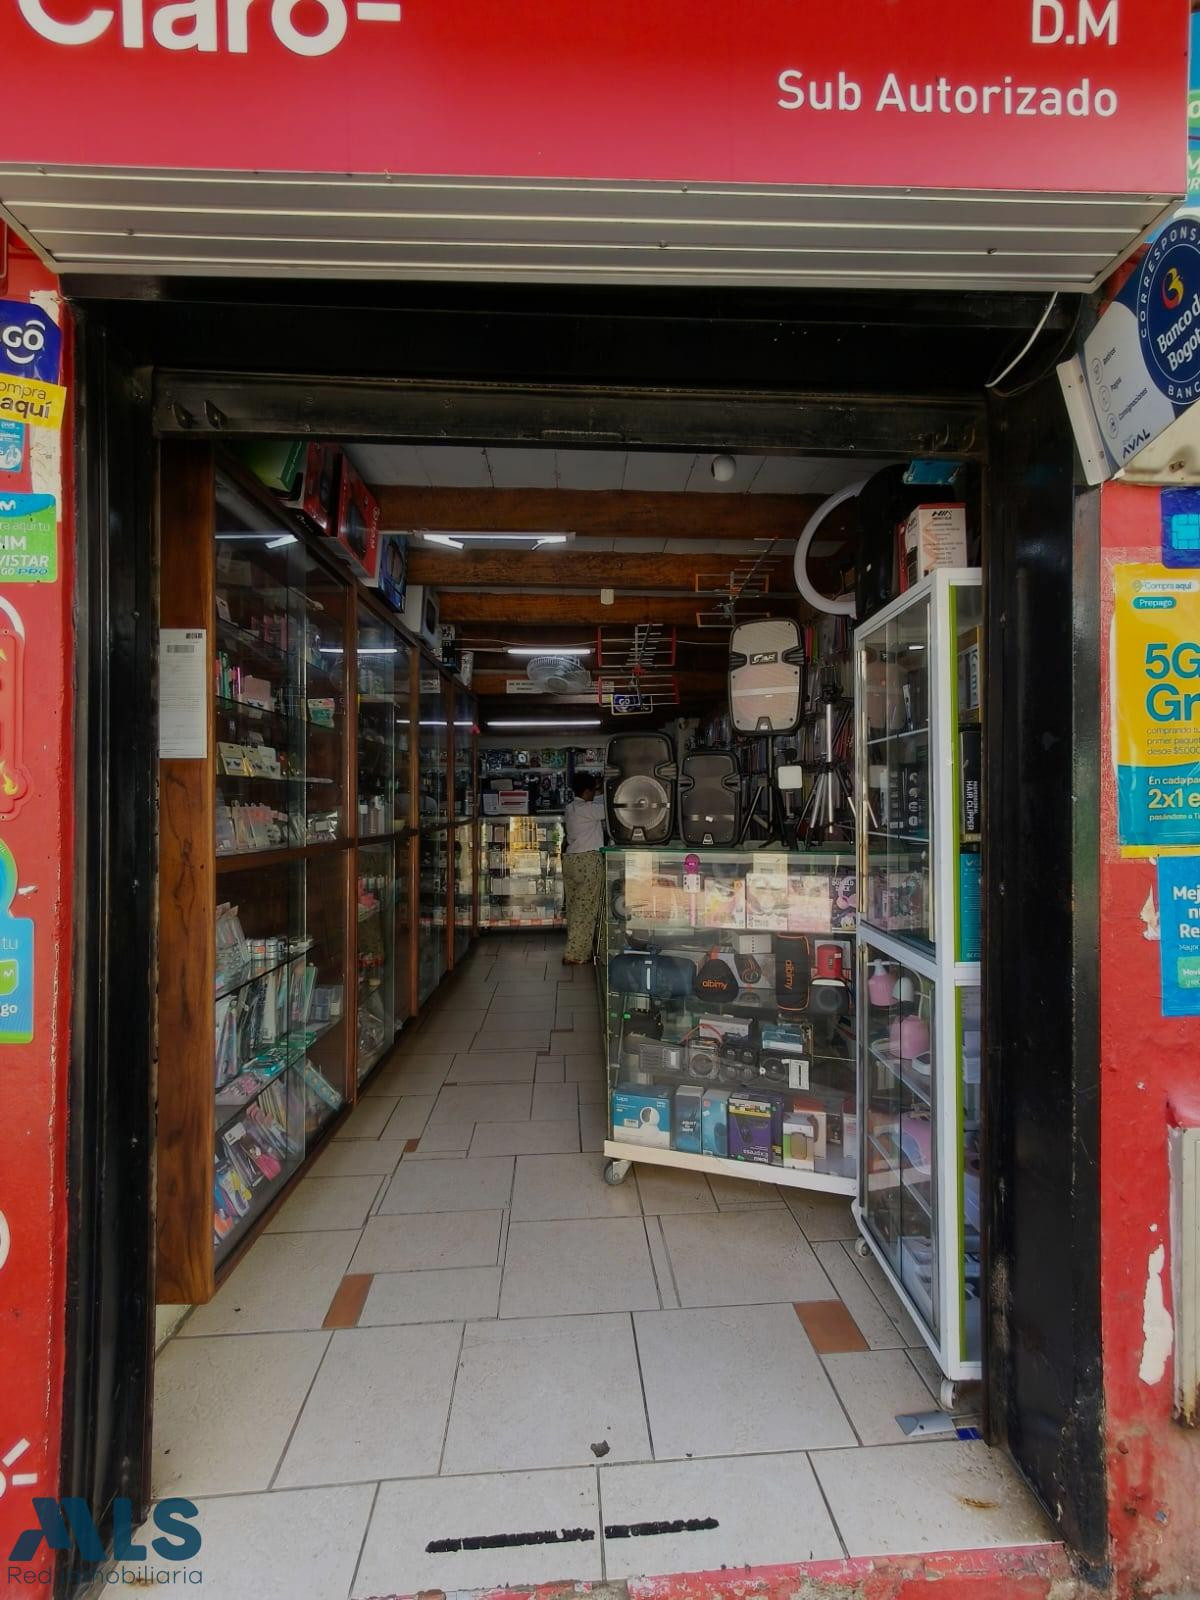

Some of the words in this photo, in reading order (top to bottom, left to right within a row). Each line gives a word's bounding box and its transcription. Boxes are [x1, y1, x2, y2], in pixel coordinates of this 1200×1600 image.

[1031, 0, 1119, 46] D.M
[777, 70, 862, 112] Sub
[876, 73, 1118, 117] Autorizado
[1156, 309, 1193, 354] Banco
[1139, 599, 1173, 608] Prepago
[1145, 642, 1200, 680] 5G
[966, 780, 975, 799] HAIR
[1148, 788, 1184, 809] 2x1
[966, 800, 975, 831] CLIPPER
